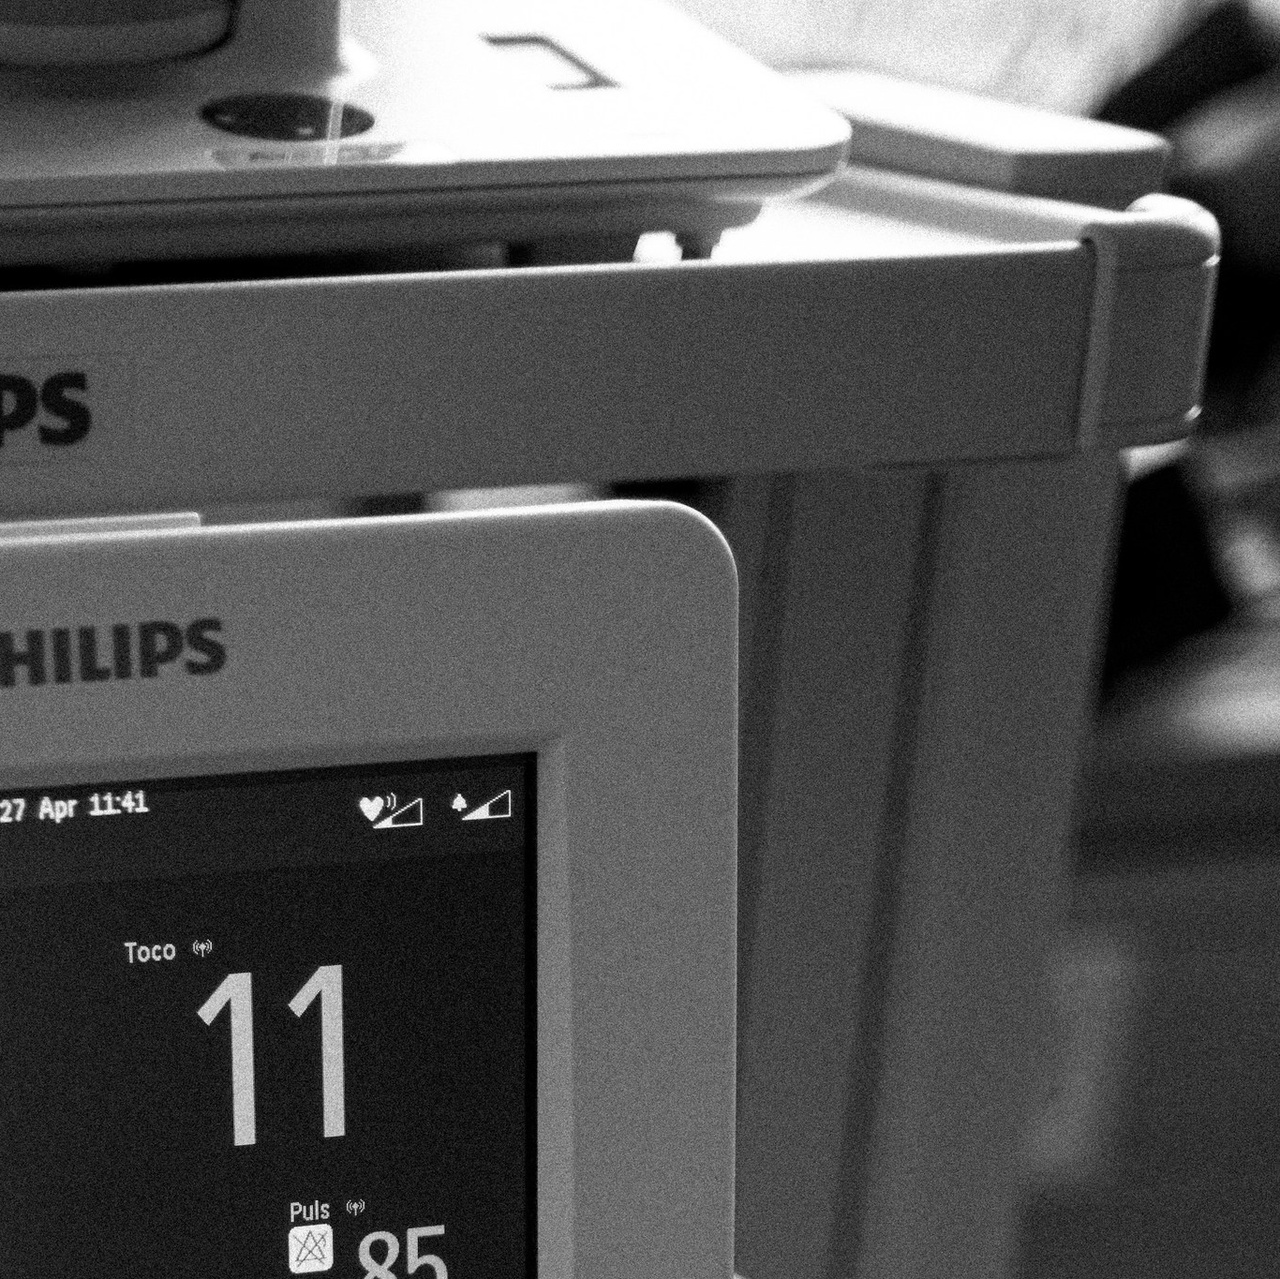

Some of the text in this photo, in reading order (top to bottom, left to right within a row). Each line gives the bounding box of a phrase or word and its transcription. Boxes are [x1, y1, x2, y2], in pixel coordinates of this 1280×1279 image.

[39, 796, 77, 823] Apr
[90, 790, 150, 816] 11:41
[124, 941, 176, 964] Toco
[196, 964, 346, 1146] 11
[289, 1200, 331, 1223] Puls
